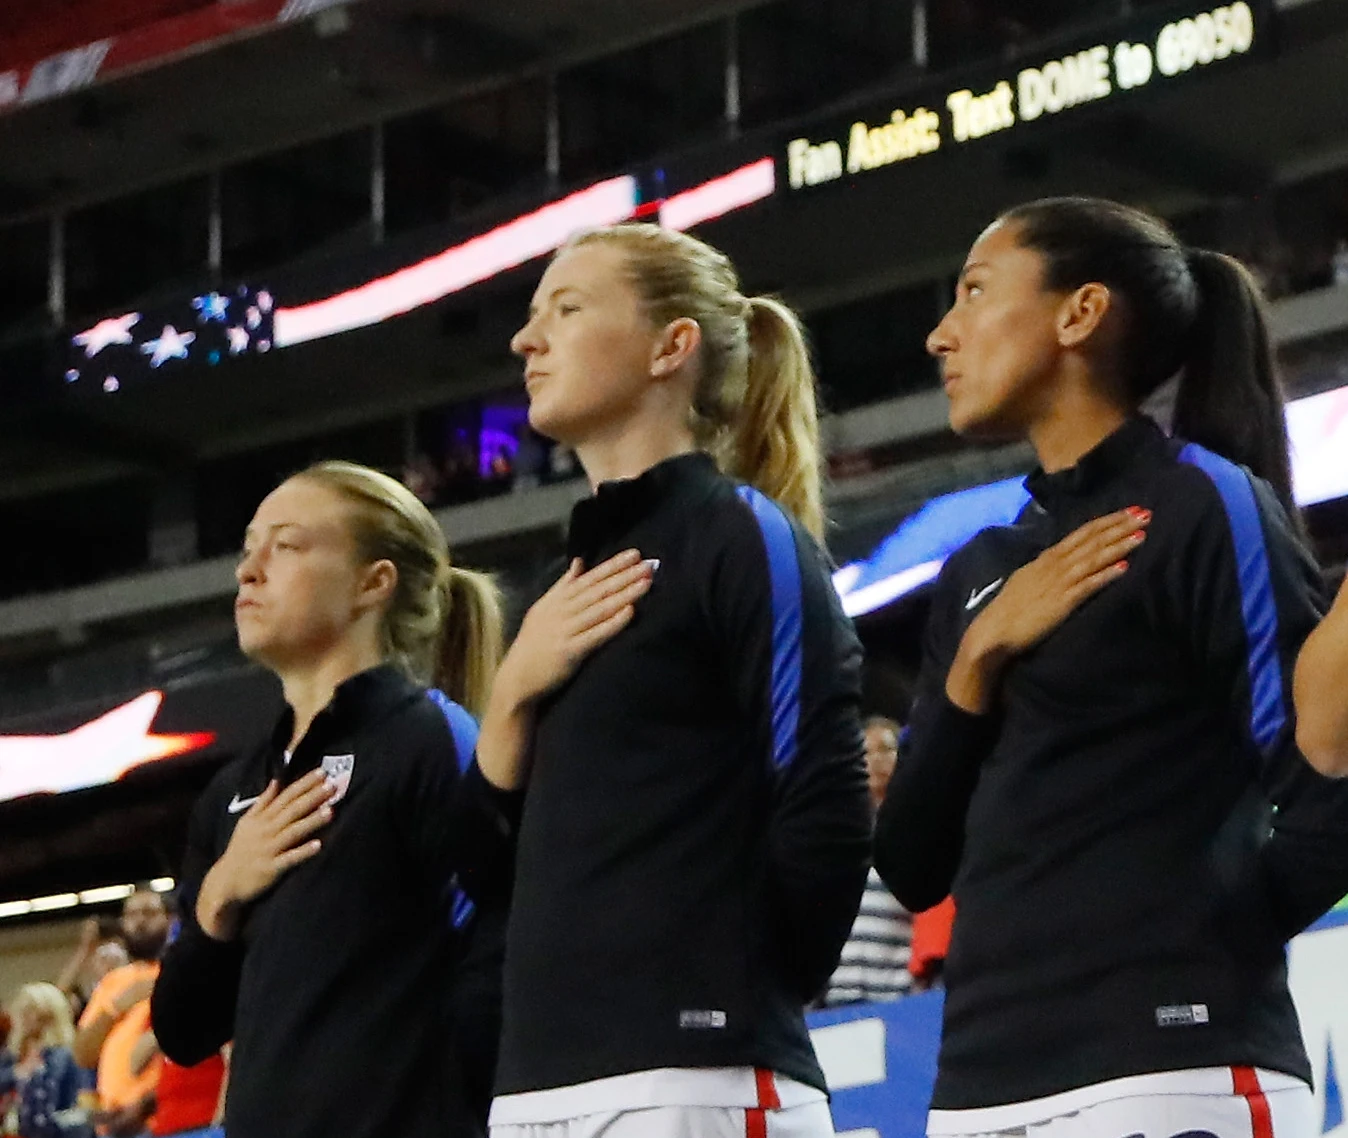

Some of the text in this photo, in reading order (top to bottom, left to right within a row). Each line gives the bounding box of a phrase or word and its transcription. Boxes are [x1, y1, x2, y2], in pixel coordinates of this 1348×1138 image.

[787, 1, 1254, 190] Fan Assist: Text DOME to 69050
